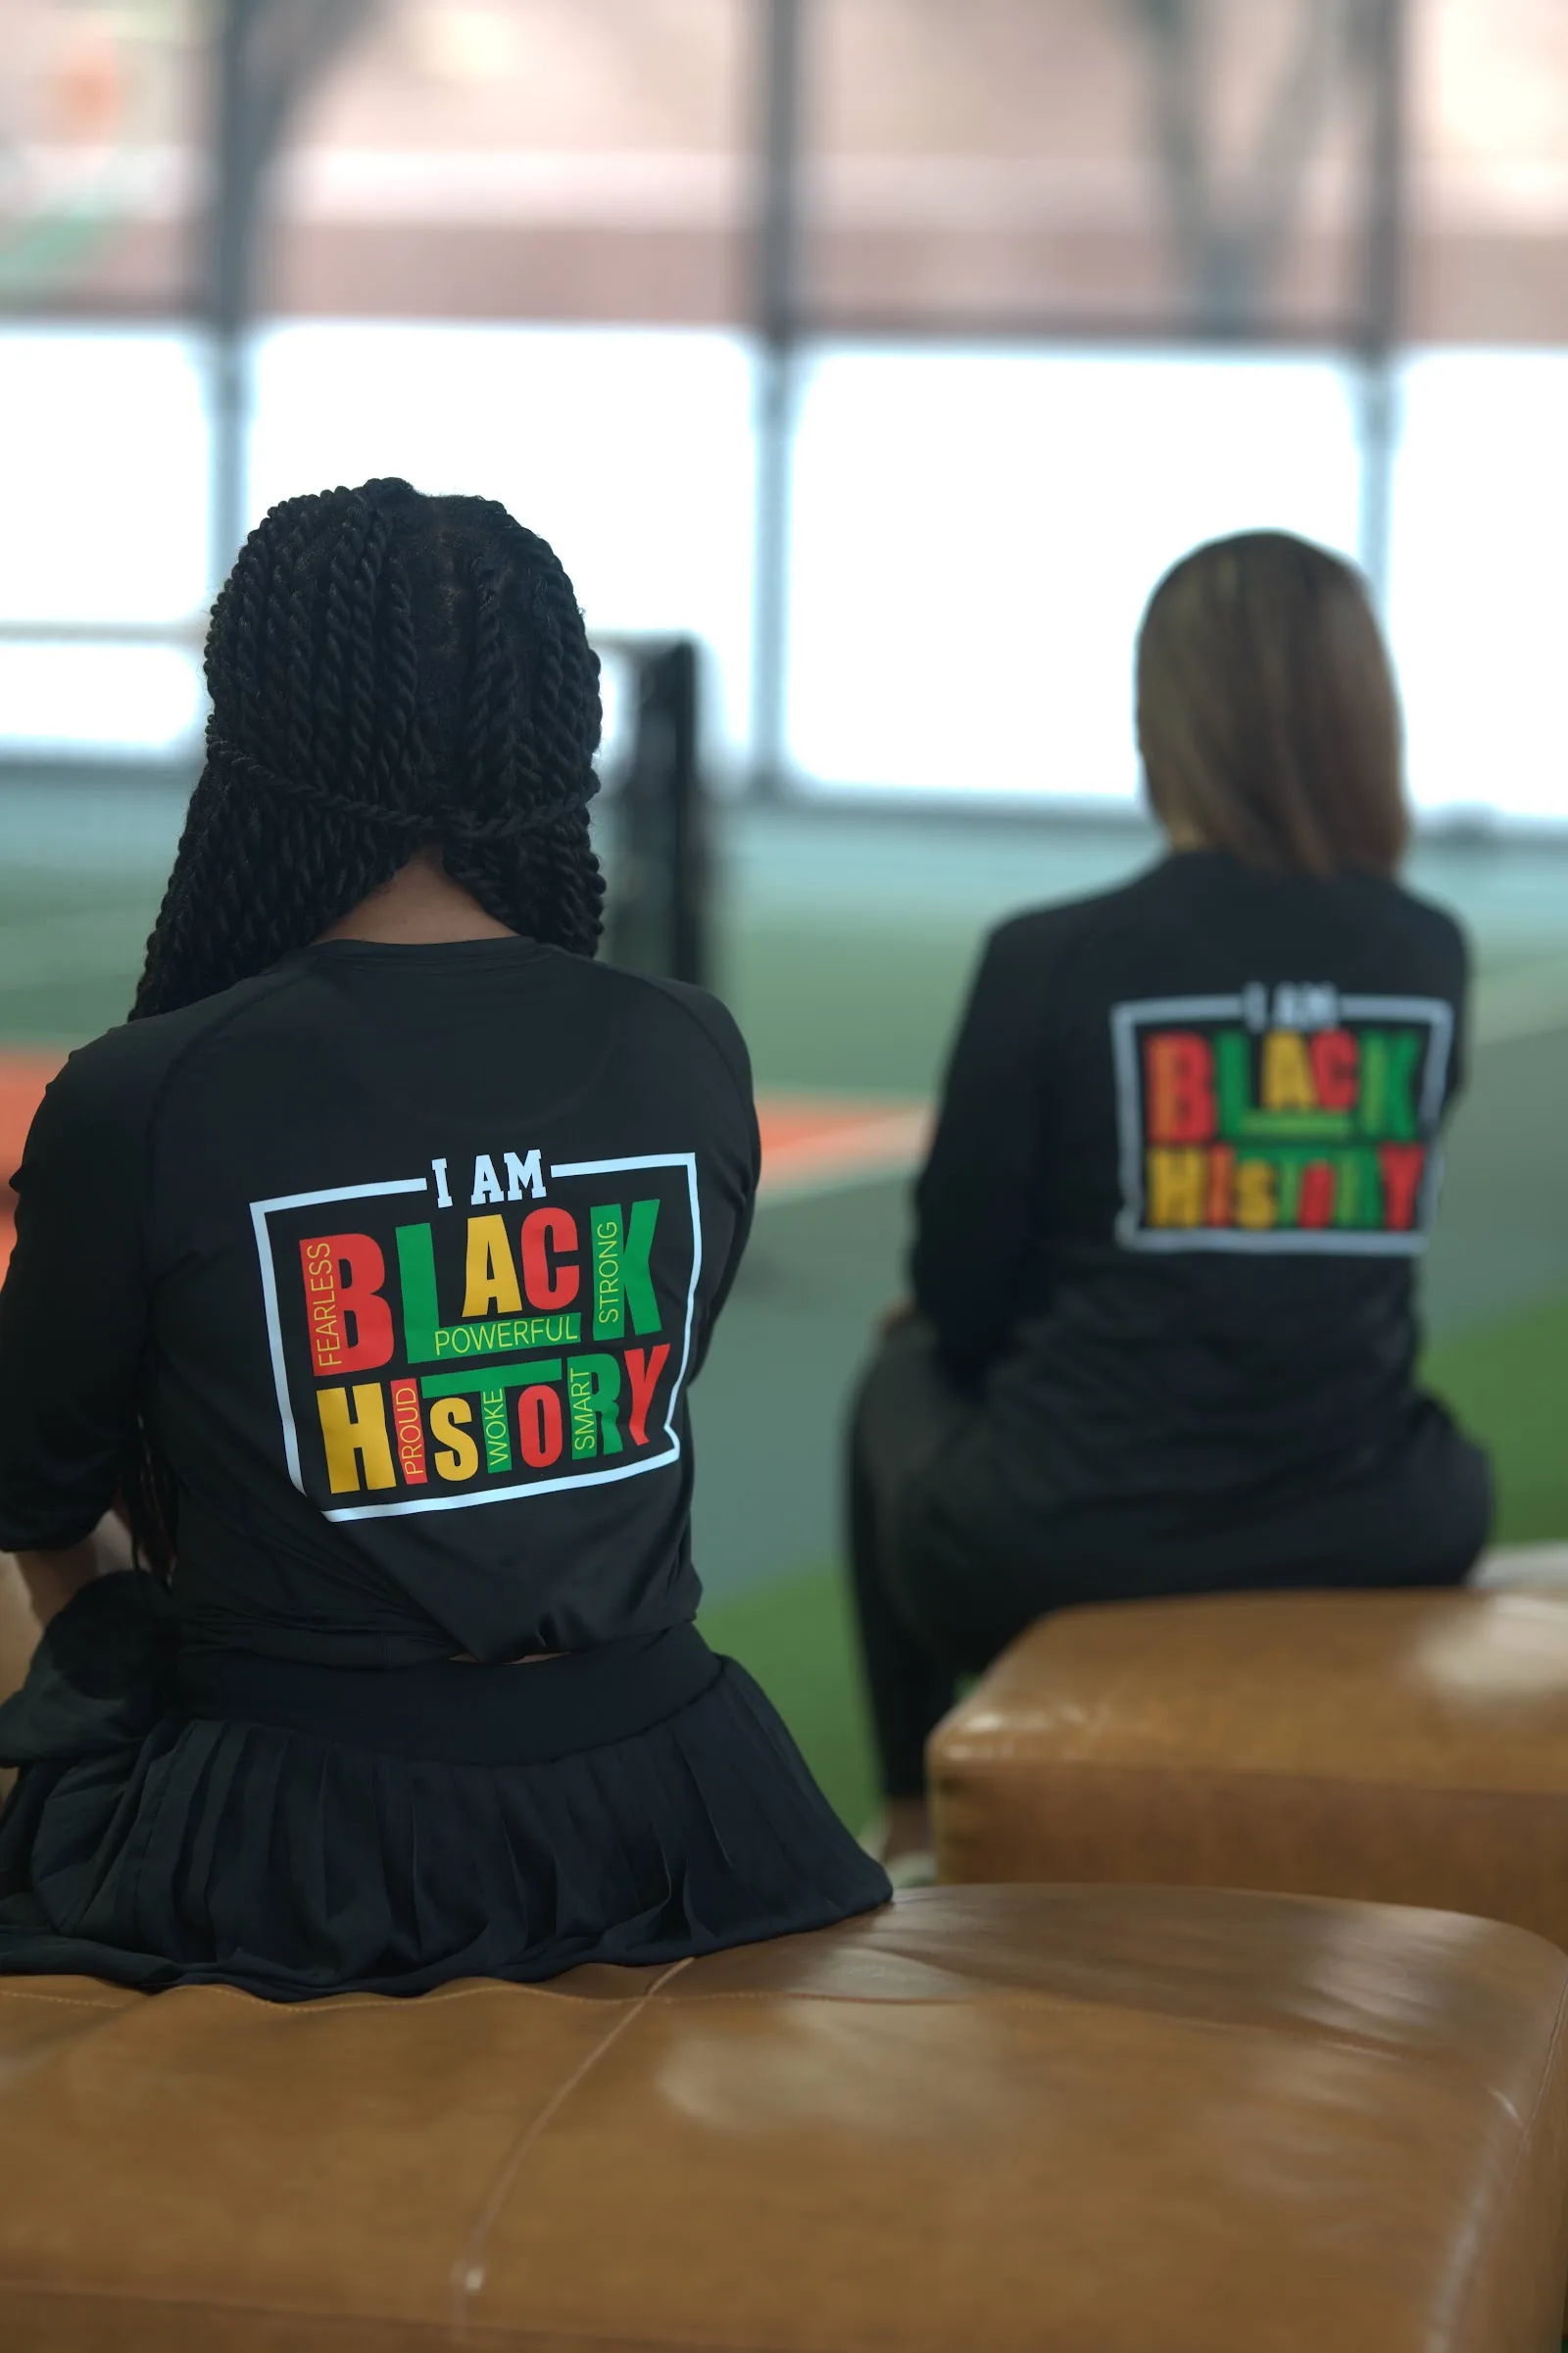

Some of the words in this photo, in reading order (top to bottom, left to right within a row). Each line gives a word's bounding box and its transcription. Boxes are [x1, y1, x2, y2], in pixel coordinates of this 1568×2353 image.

[1145, 1029, 1420, 1144] BLACK
[431, 1157, 453, 1208] I
[470, 1149, 547, 1205] AM
[299, 1199, 662, 1377] BLACK
[307, 1242, 343, 1367] FEARLESS
[596, 1220, 619, 1324] STRONG
[435, 1316, 578, 1356] POWERFUL
[316, 1344, 670, 1495] HISTORY
[397, 1387, 424, 1476] PROUD
[483, 1388, 509, 1467] WOKE
[570, 1367, 596, 1451] SMART
